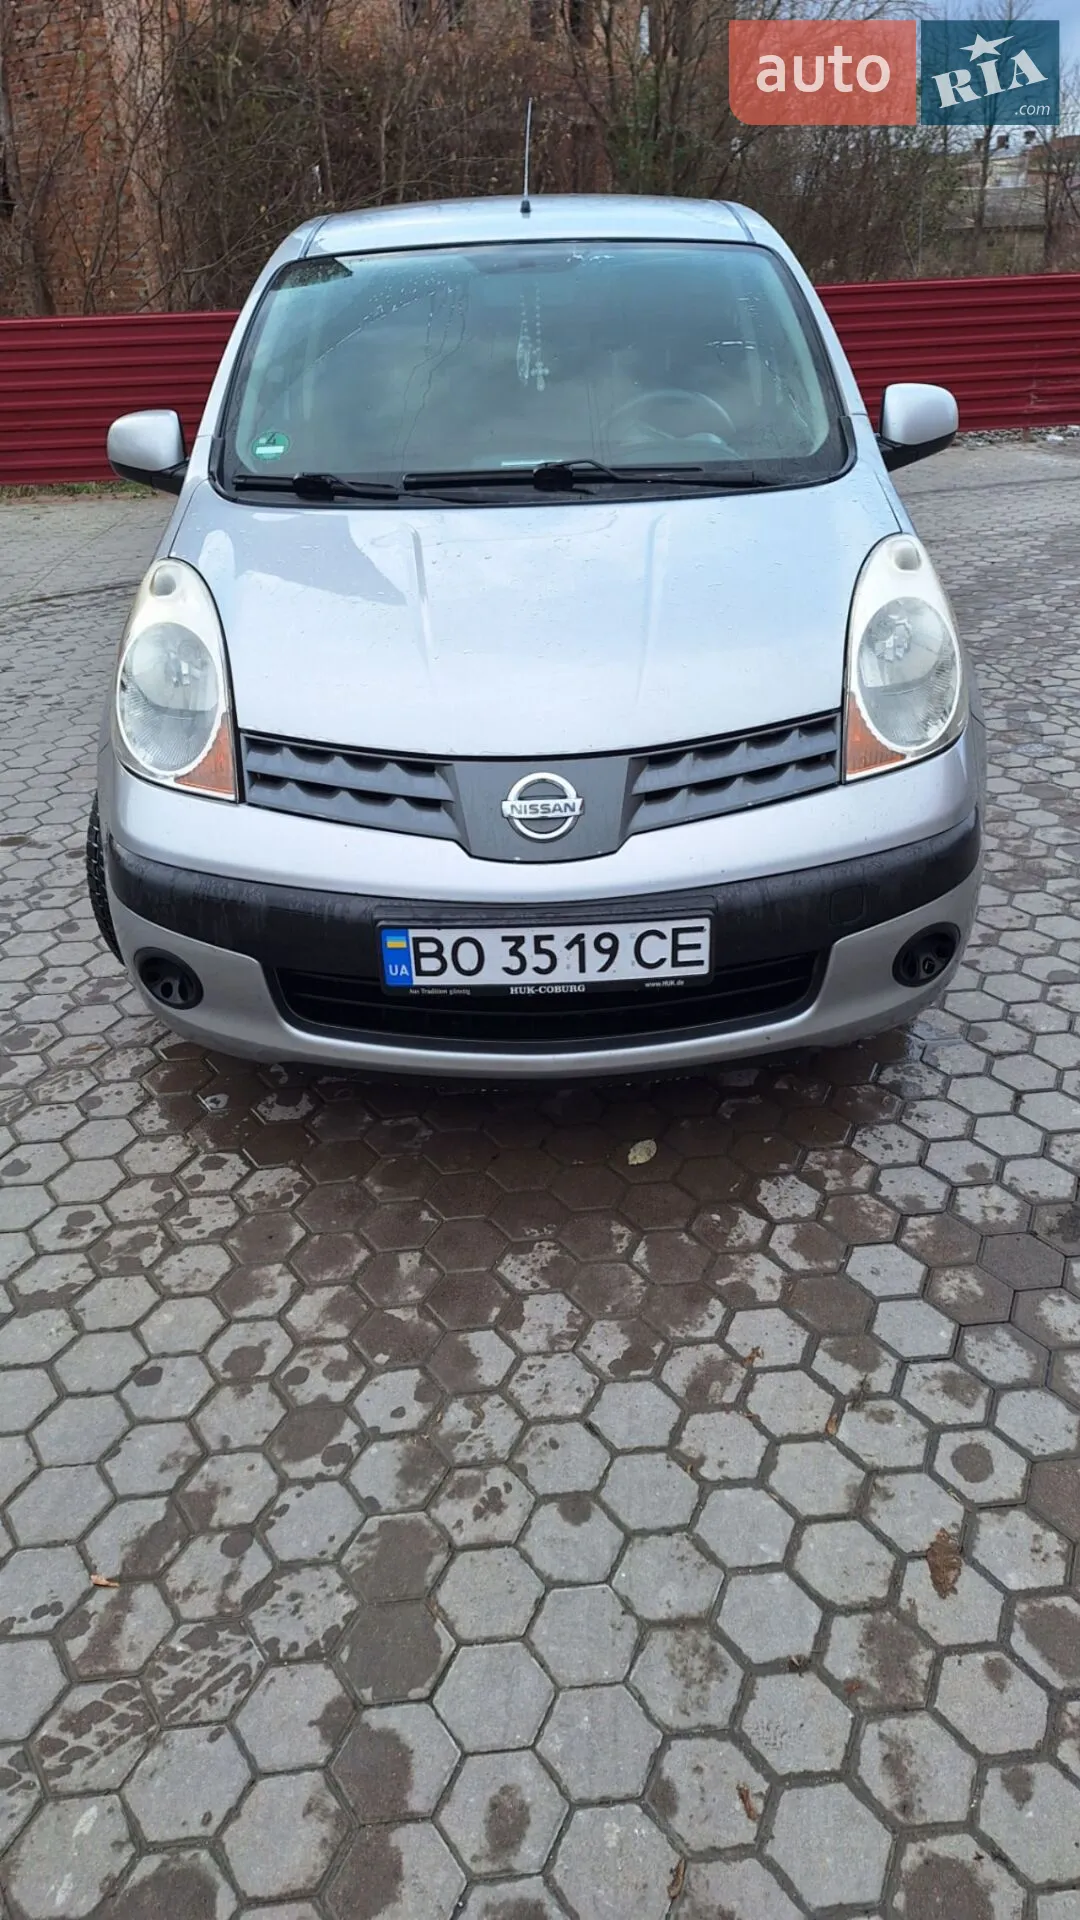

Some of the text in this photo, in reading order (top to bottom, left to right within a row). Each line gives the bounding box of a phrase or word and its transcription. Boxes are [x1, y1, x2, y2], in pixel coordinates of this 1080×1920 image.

[510, 802, 576, 815] NISSAN
[412, 926, 705, 977] BO 3519 CE
[388, 964, 409, 977] UA
[510, 984, 586, 995] HUK-COBURG
